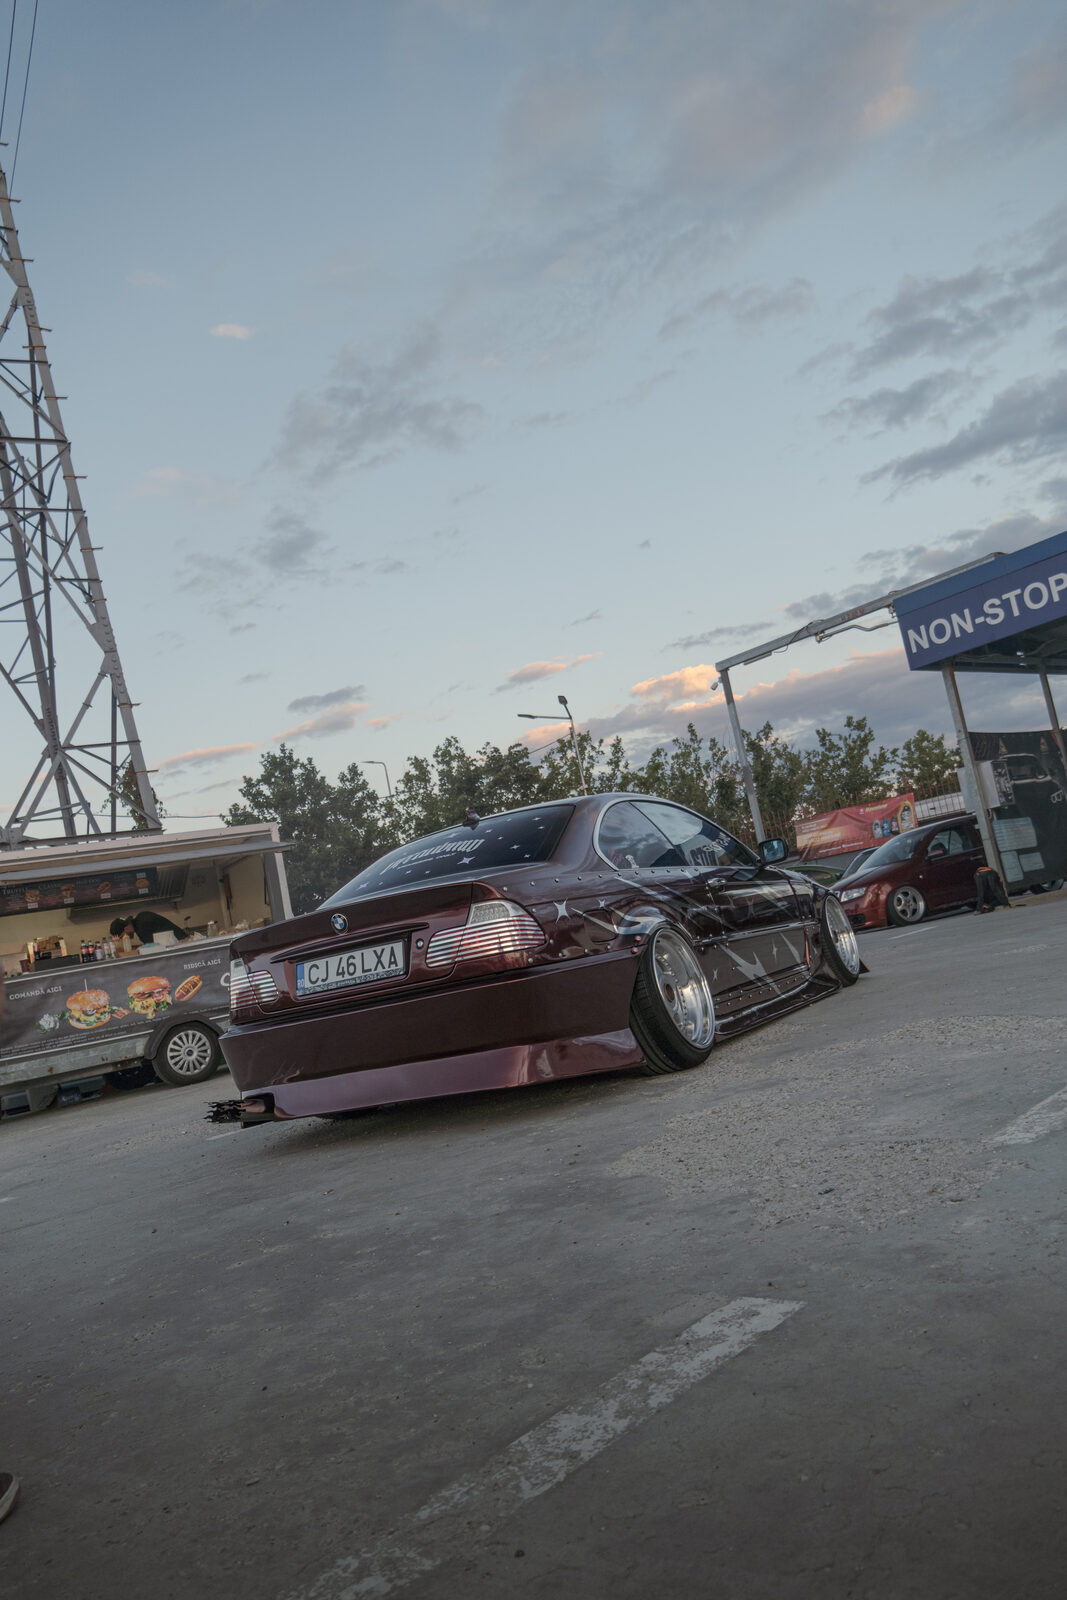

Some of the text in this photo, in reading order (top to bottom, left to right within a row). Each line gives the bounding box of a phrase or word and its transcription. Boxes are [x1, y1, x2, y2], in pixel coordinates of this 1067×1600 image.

[907, 572, 1067, 653] NON-STOP
[308, 961, 329, 985] CJ
[336, 955, 357, 978] 46
[361, 946, 398, 974] LXA
[46, 986, 62, 994] AICI
